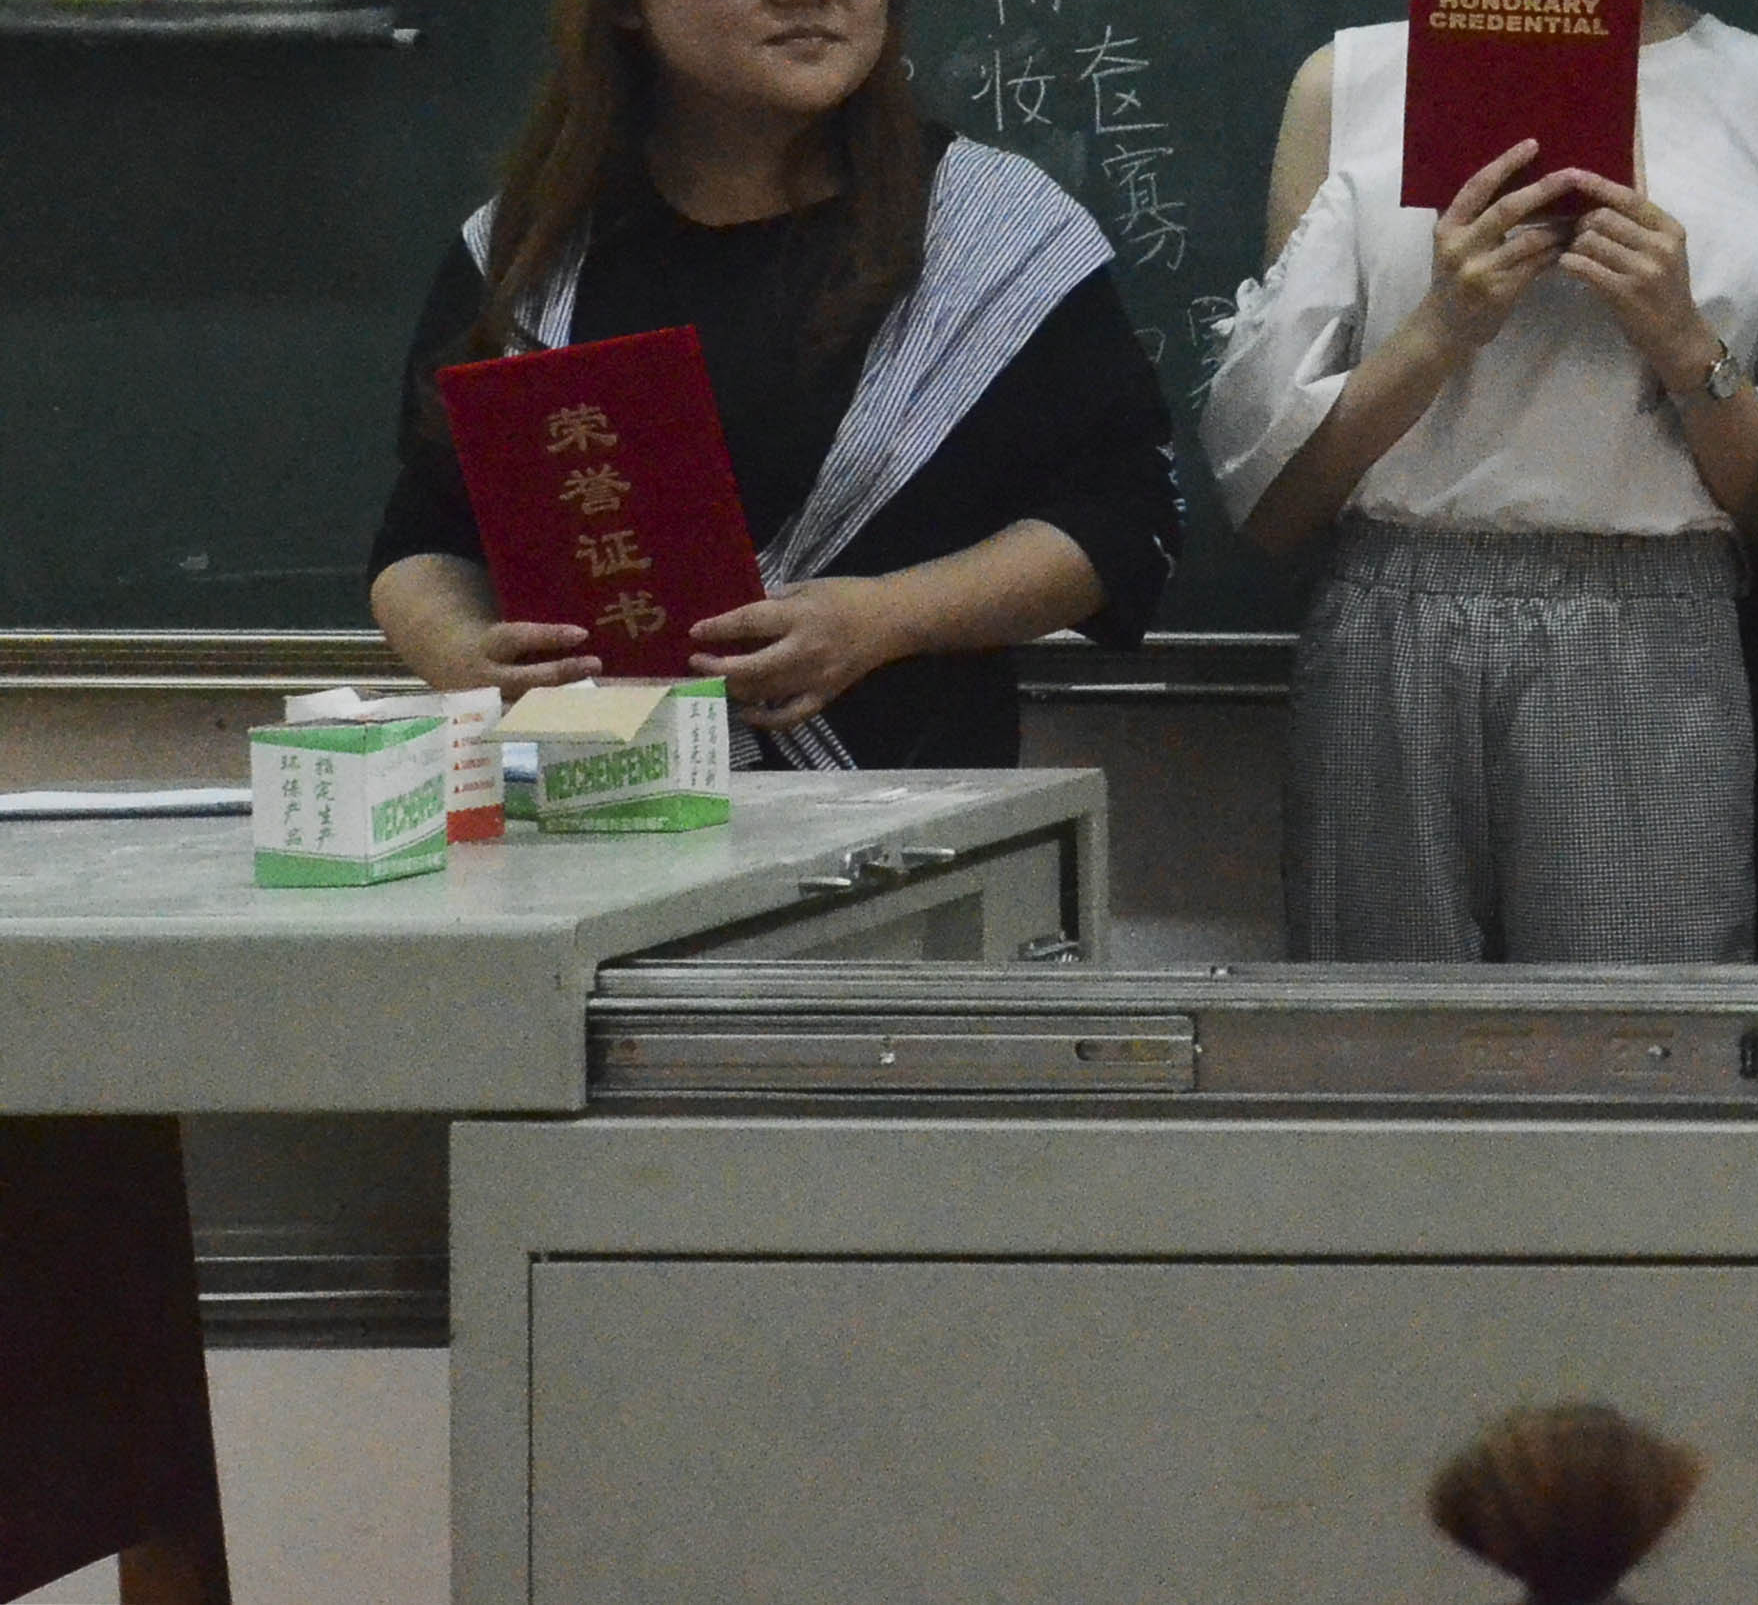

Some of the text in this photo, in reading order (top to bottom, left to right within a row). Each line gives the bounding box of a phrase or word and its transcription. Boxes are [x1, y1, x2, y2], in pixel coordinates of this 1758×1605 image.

[1428, 13, 1609, 35] CREDENTIAL
[546, 402, 668, 640] 荣誉证书
